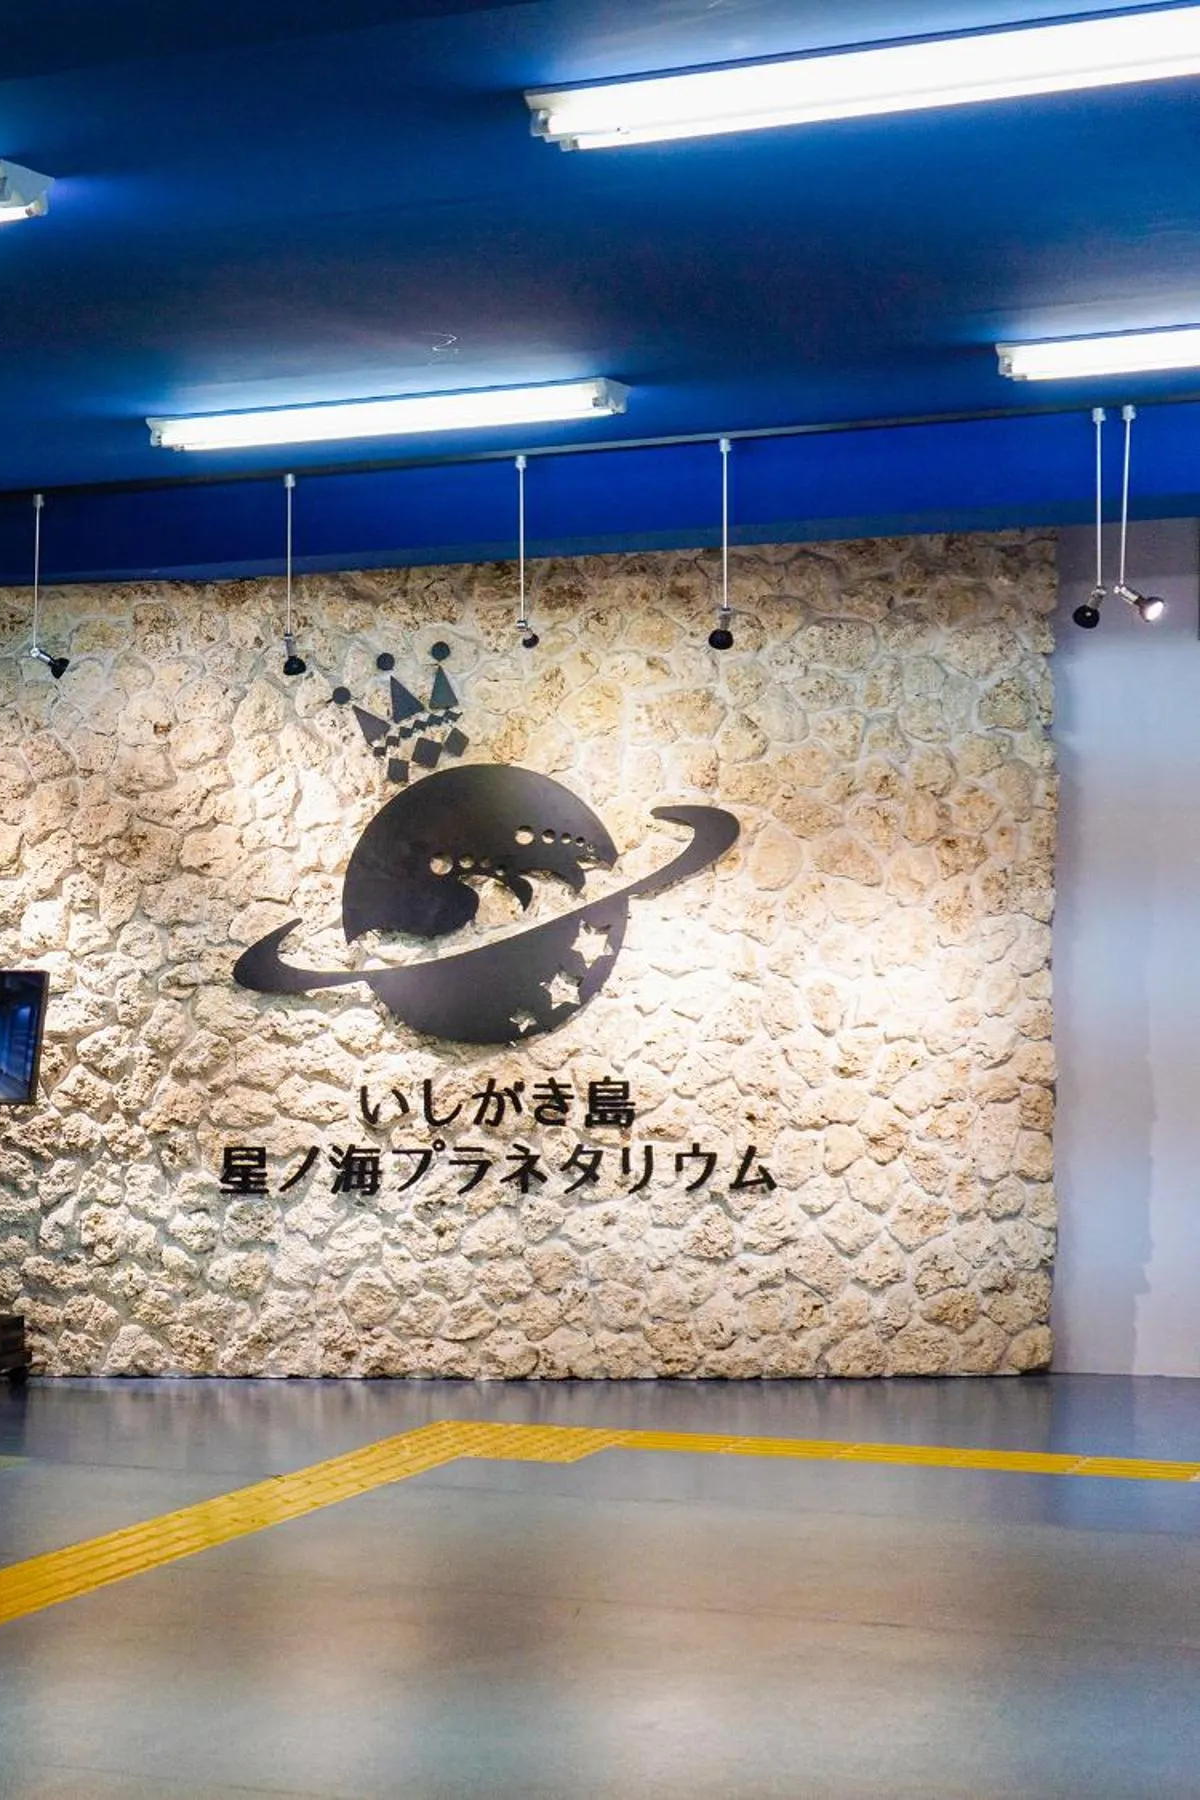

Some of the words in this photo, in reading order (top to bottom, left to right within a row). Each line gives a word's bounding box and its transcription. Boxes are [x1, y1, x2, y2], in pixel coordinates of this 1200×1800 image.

[359, 1076, 634, 1128] いしがき島
[219, 1139, 777, 1196] 星ノ海プラネタリウム
